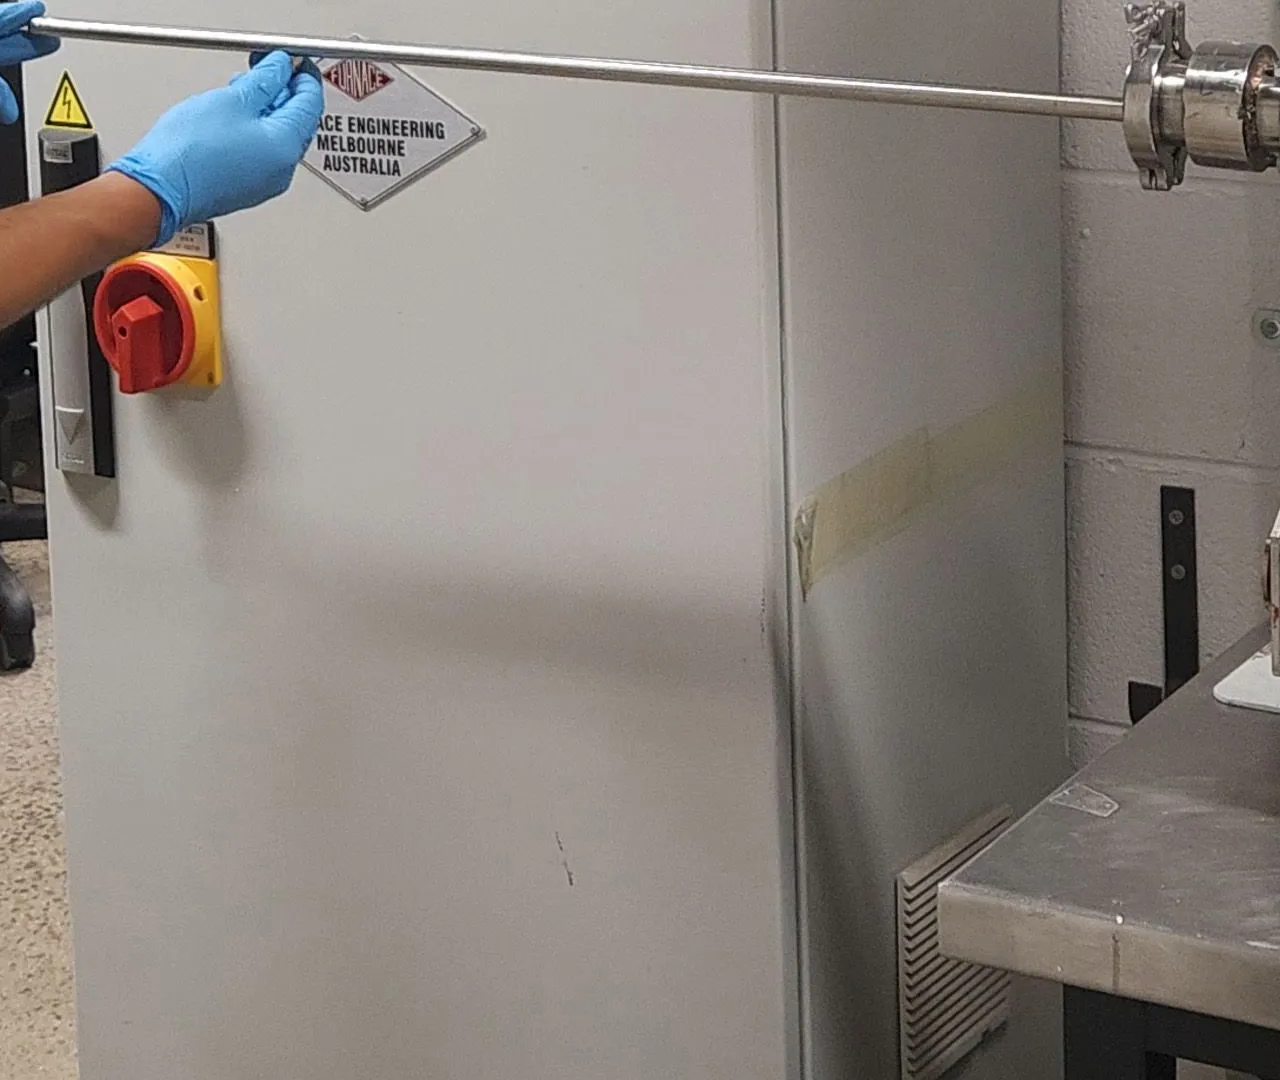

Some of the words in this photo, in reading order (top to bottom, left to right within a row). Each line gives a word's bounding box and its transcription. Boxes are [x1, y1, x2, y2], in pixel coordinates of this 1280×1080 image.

[331, 59, 384, 101] FURNACE
[348, 116, 446, 140] ENGINEERING
[317, 134, 406, 157] MELBOURNE
[323, 154, 401, 177] AUSTRALIA
